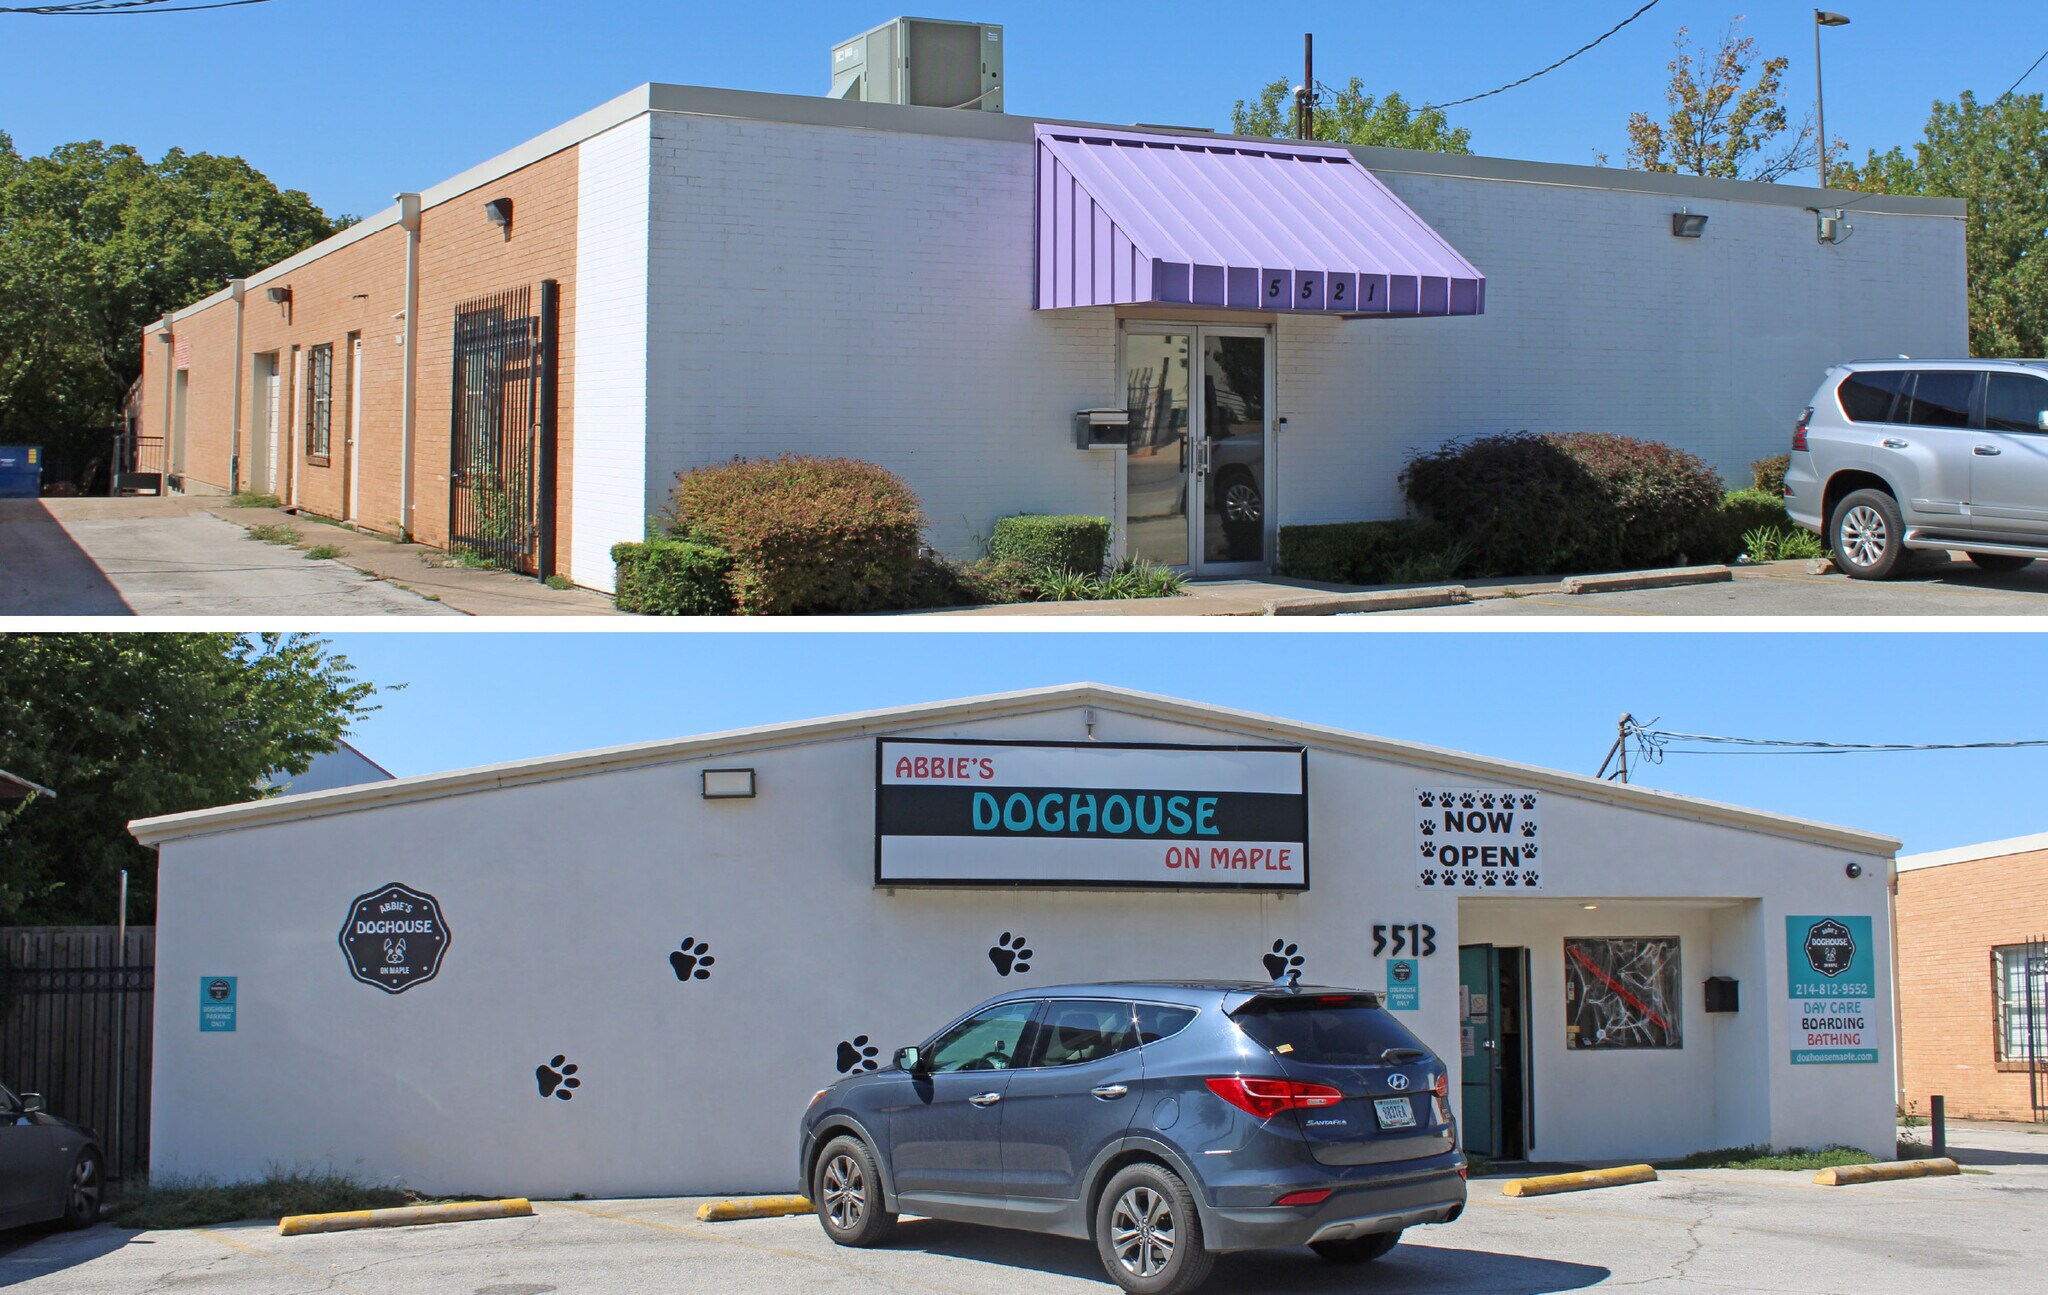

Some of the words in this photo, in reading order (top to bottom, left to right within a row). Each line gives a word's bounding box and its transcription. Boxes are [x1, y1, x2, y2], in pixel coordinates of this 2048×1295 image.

[1269, 279, 1375, 301] 5521
[896, 756, 994, 780] ABBIE'S
[973, 791, 1220, 835] DOGHOUSE
[1444, 811, 1514, 833] NOW
[1165, 846, 1200, 869] ON
[1210, 847, 1292, 871] MAPLE
[1439, 845, 1520, 867] OPEN
[379, 901, 413, 914] ABBIE'S
[356, 920, 432, 934] DOGHOUSE
[1373, 924, 1436, 957] 5513
[1811, 938, 1848, 946] DOGHOUSE
[389, 966, 410, 974] MAPLE
[1795, 983, 1868, 995] 214-812-9552
[1804, 1002, 1827, 1014] DAY
[1829, 1001, 1862, 1014] CARE
[1802, 1017, 1864, 1030] BOARDING
[1807, 1033, 1861, 1045] BATHING
